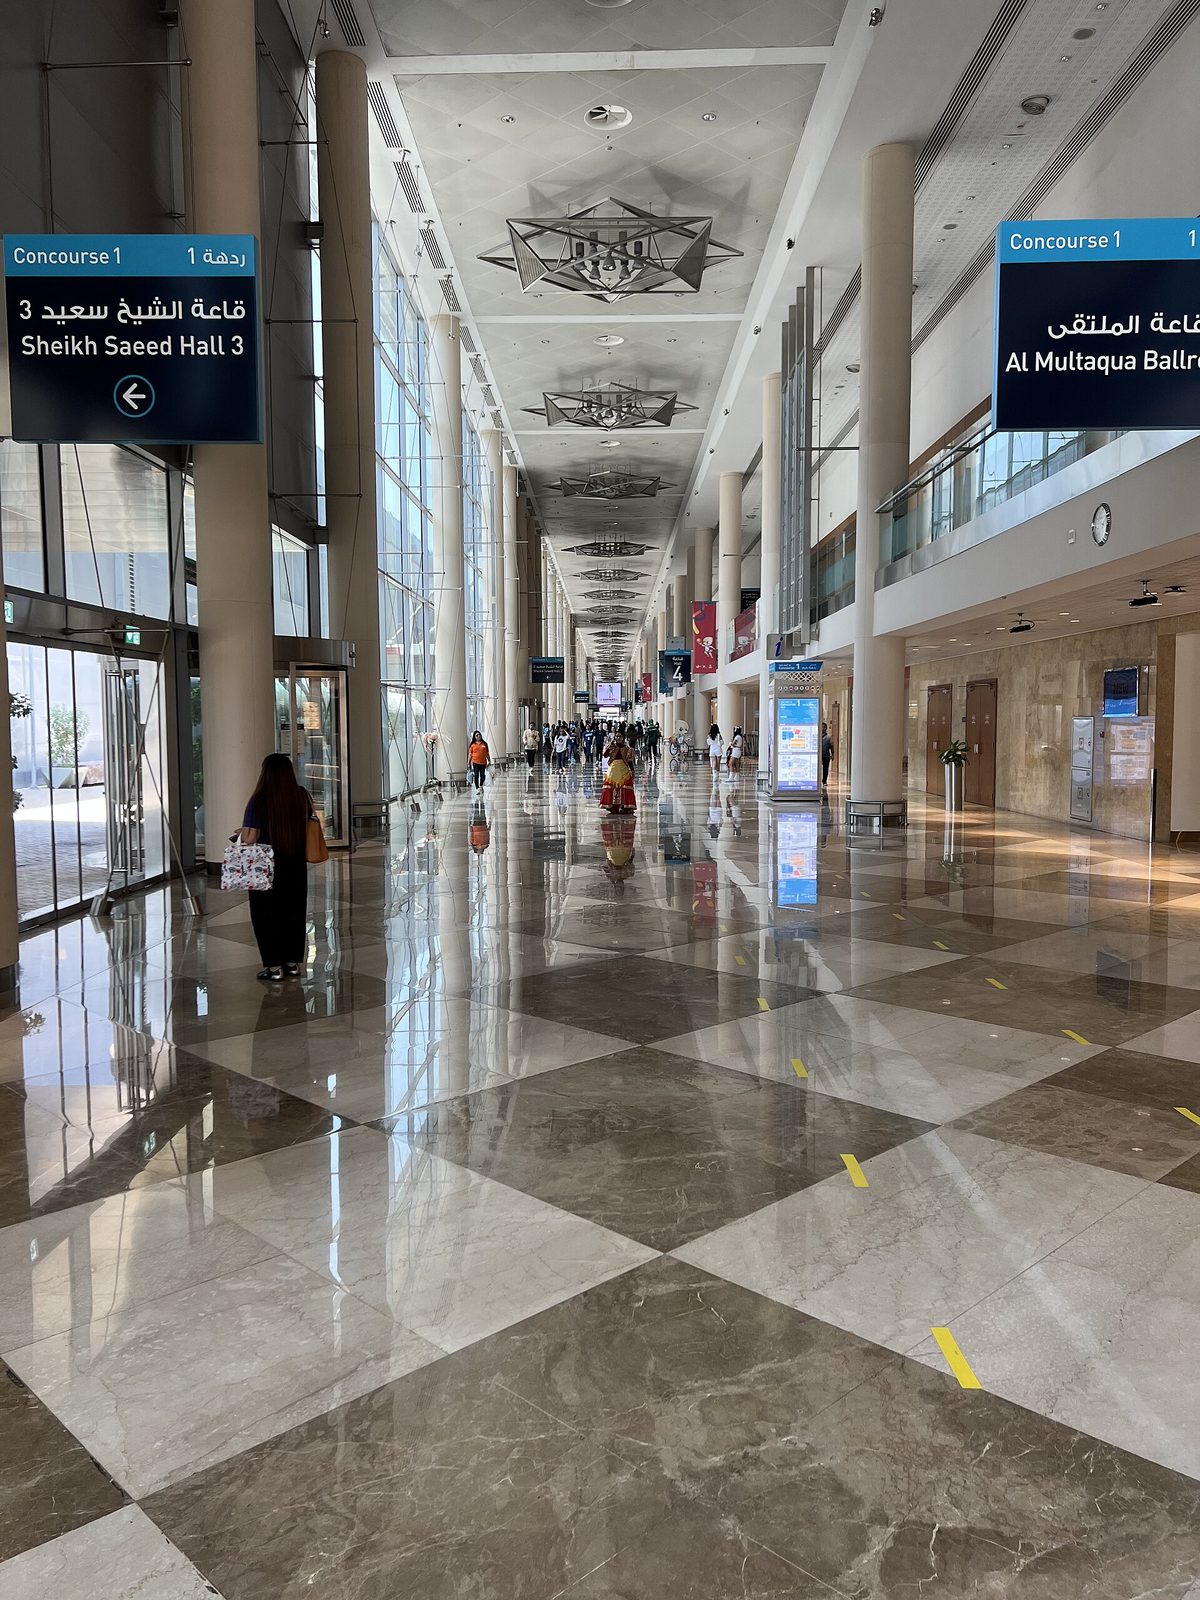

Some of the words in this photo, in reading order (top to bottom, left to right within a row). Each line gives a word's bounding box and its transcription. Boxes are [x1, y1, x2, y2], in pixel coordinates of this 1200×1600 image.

[1010, 233, 1109, 250] Concourse
[1113, 230, 1120, 248] 1
[1188, 229, 1196, 247] 1
[14, 247, 110, 264] Concourse
[113, 247, 121, 264] 1
[187, 247, 195, 265] 1
[203, 248, 246, 267] ردهة
[19, 300, 32, 320] 3
[41, 305, 108, 325] سعيد
[117, 296, 183, 325] الشيخ
[190, 298, 246, 320] قاعة
[1047, 313, 1140, 340] الملتقى
[21, 335, 98, 356] Sheikh
[104, 335, 172, 356] Saeed
[180, 335, 225, 356] Hall
[231, 335, 244, 356] 3
[1005, 351, 1029, 372] Al
[1035, 350, 1137, 376] Multaqua
[1143, 349, 1200, 370] Ballr
[672, 665, 683, 681] 4
